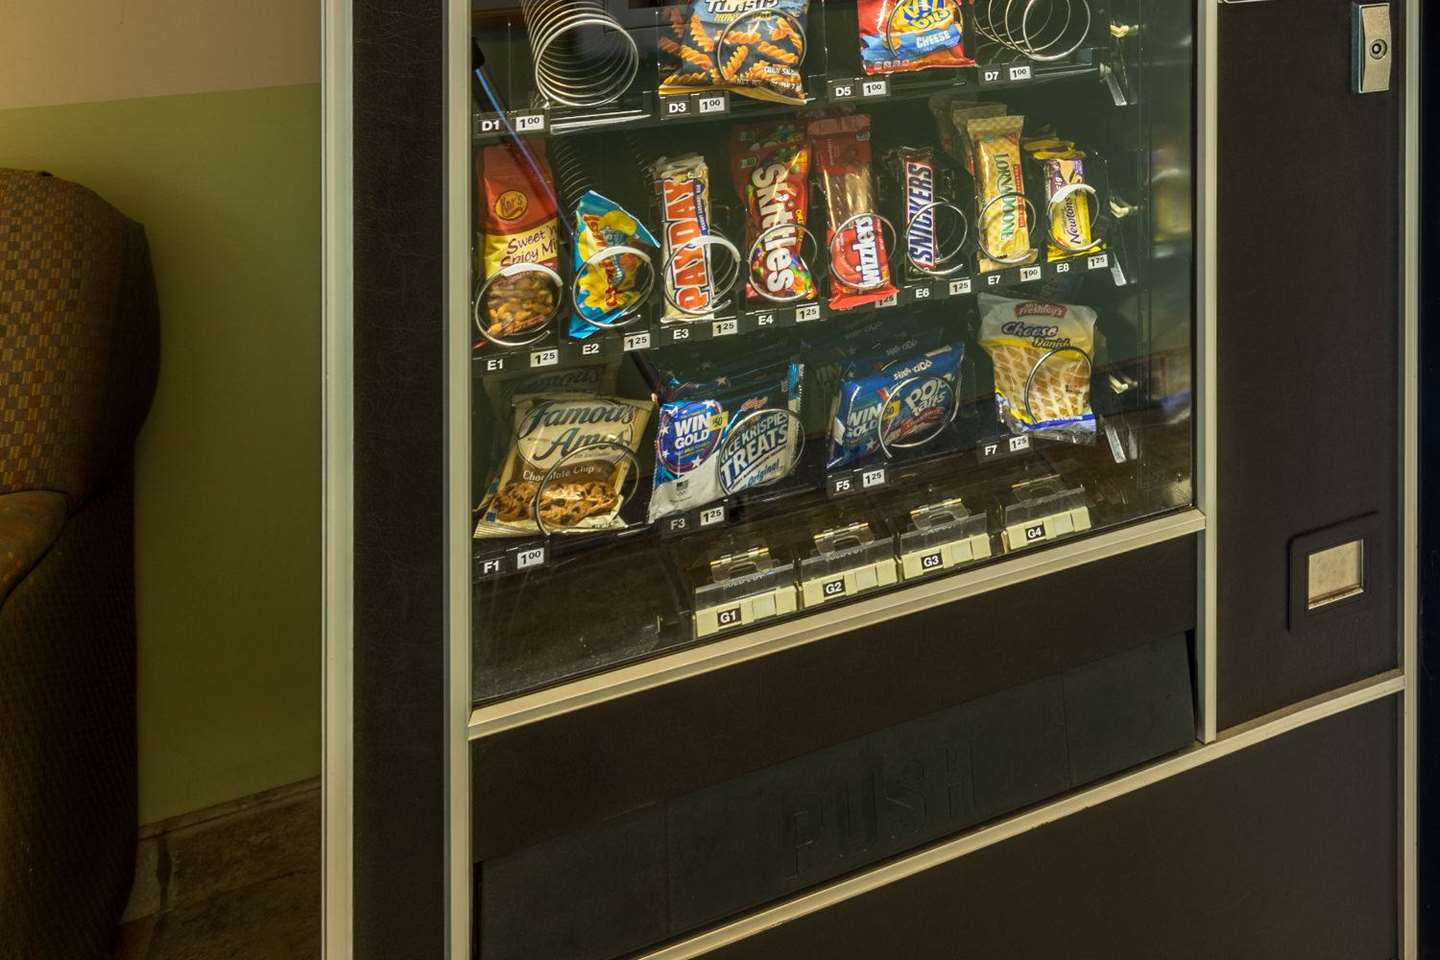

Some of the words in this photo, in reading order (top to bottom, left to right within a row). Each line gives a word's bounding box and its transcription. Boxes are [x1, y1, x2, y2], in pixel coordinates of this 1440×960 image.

[916, 30, 952, 49] CHEESE
[984, 71, 999, 81] D7
[835, 86, 851, 97] D5
[669, 102, 686, 113] D3
[481, 119, 499, 131] D1
[908, 163, 934, 265] SNICKERS
[1000, 196, 1016, 240] DOONE
[1063, 195, 1082, 245] Newtons
[752, 163, 797, 293] Skittles
[507, 230, 545, 255] Sweet
[664, 179, 710, 311] PAYDAY
[1057, 263, 1070, 273] E8
[988, 275, 1001, 286] E7
[915, 288, 930, 299] E6
[758, 314, 774, 326] E4
[673, 328, 689, 340] E3
[1002, 321, 1059, 338] Cheese
[582, 343, 600, 355] E2
[487, 358, 504, 371] E1
[517, 399, 635, 440] Famous
[847, 403, 882, 427] WIN
[674, 412, 711, 437] WIN
[743, 413, 788, 447] KRISPIES
[674, 430, 710, 450] GOLD
[720, 424, 788, 488] TREATS
[985, 444, 998, 456] F7
[836, 479, 850, 492] F5
[671, 519, 686, 530] F3
[1027, 526, 1042, 539] G4
[484, 561, 500, 574] F1
[923, 555, 939, 568] G3
[825, 582, 842, 595] G2
[719, 611, 737, 623] G1
